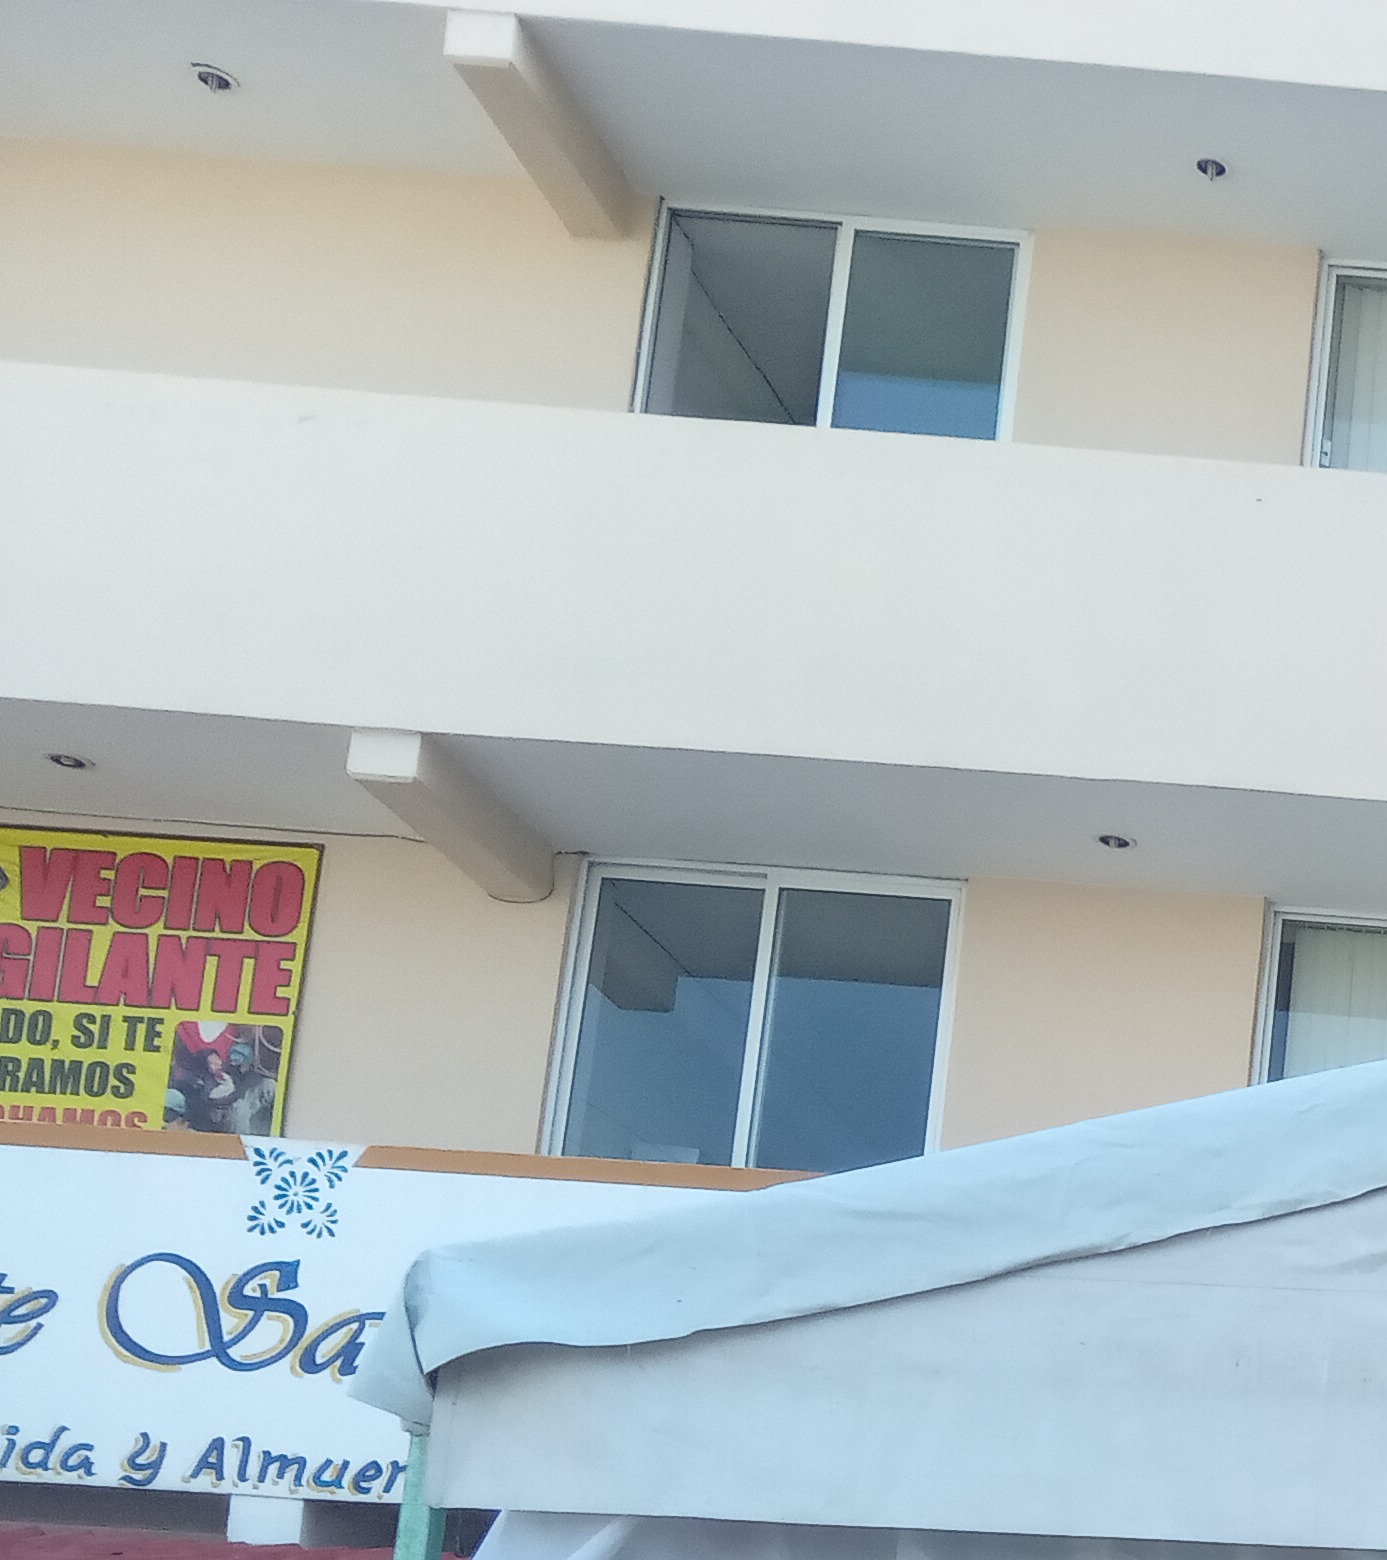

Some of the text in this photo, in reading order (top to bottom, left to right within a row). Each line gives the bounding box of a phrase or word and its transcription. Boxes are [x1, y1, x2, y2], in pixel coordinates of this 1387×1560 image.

[19, 845, 306, 937] VECINO
[0, 922, 297, 1016] GILANTE
[71, 1012, 112, 1050] SI
[122, 1014, 165, 1053] TE
[118, 1431, 168, 1487] y
